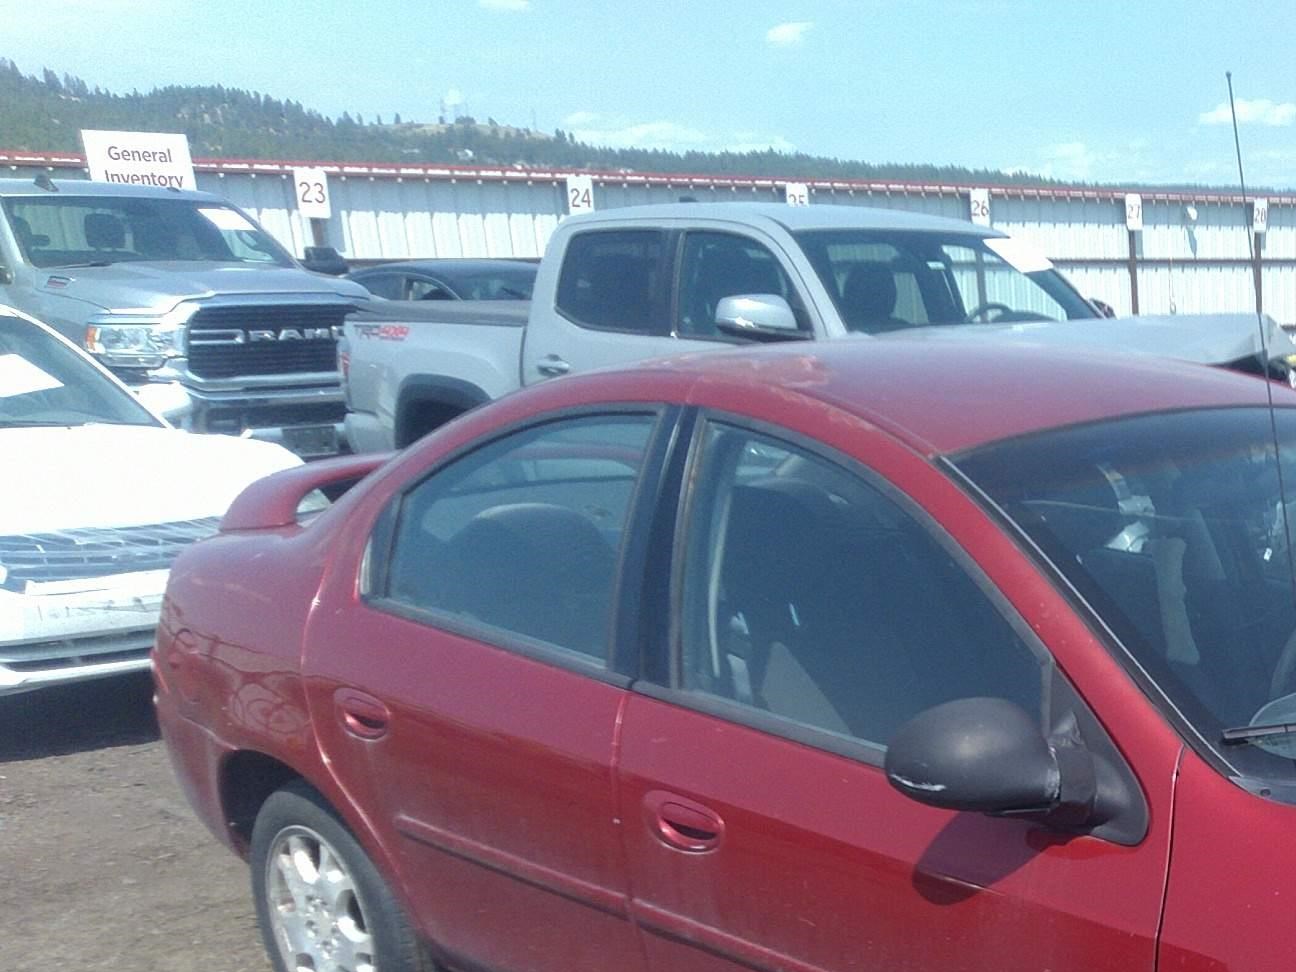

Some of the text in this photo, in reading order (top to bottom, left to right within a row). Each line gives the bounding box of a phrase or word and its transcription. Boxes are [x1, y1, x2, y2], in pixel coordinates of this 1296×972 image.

[107, 145, 172, 162] General
[104, 169, 184, 189] Inventory
[299, 182, 326, 204] 23
[570, 187, 592, 208] 24
[971, 199, 990, 217] 26
[248, 327, 330, 342] RAM
